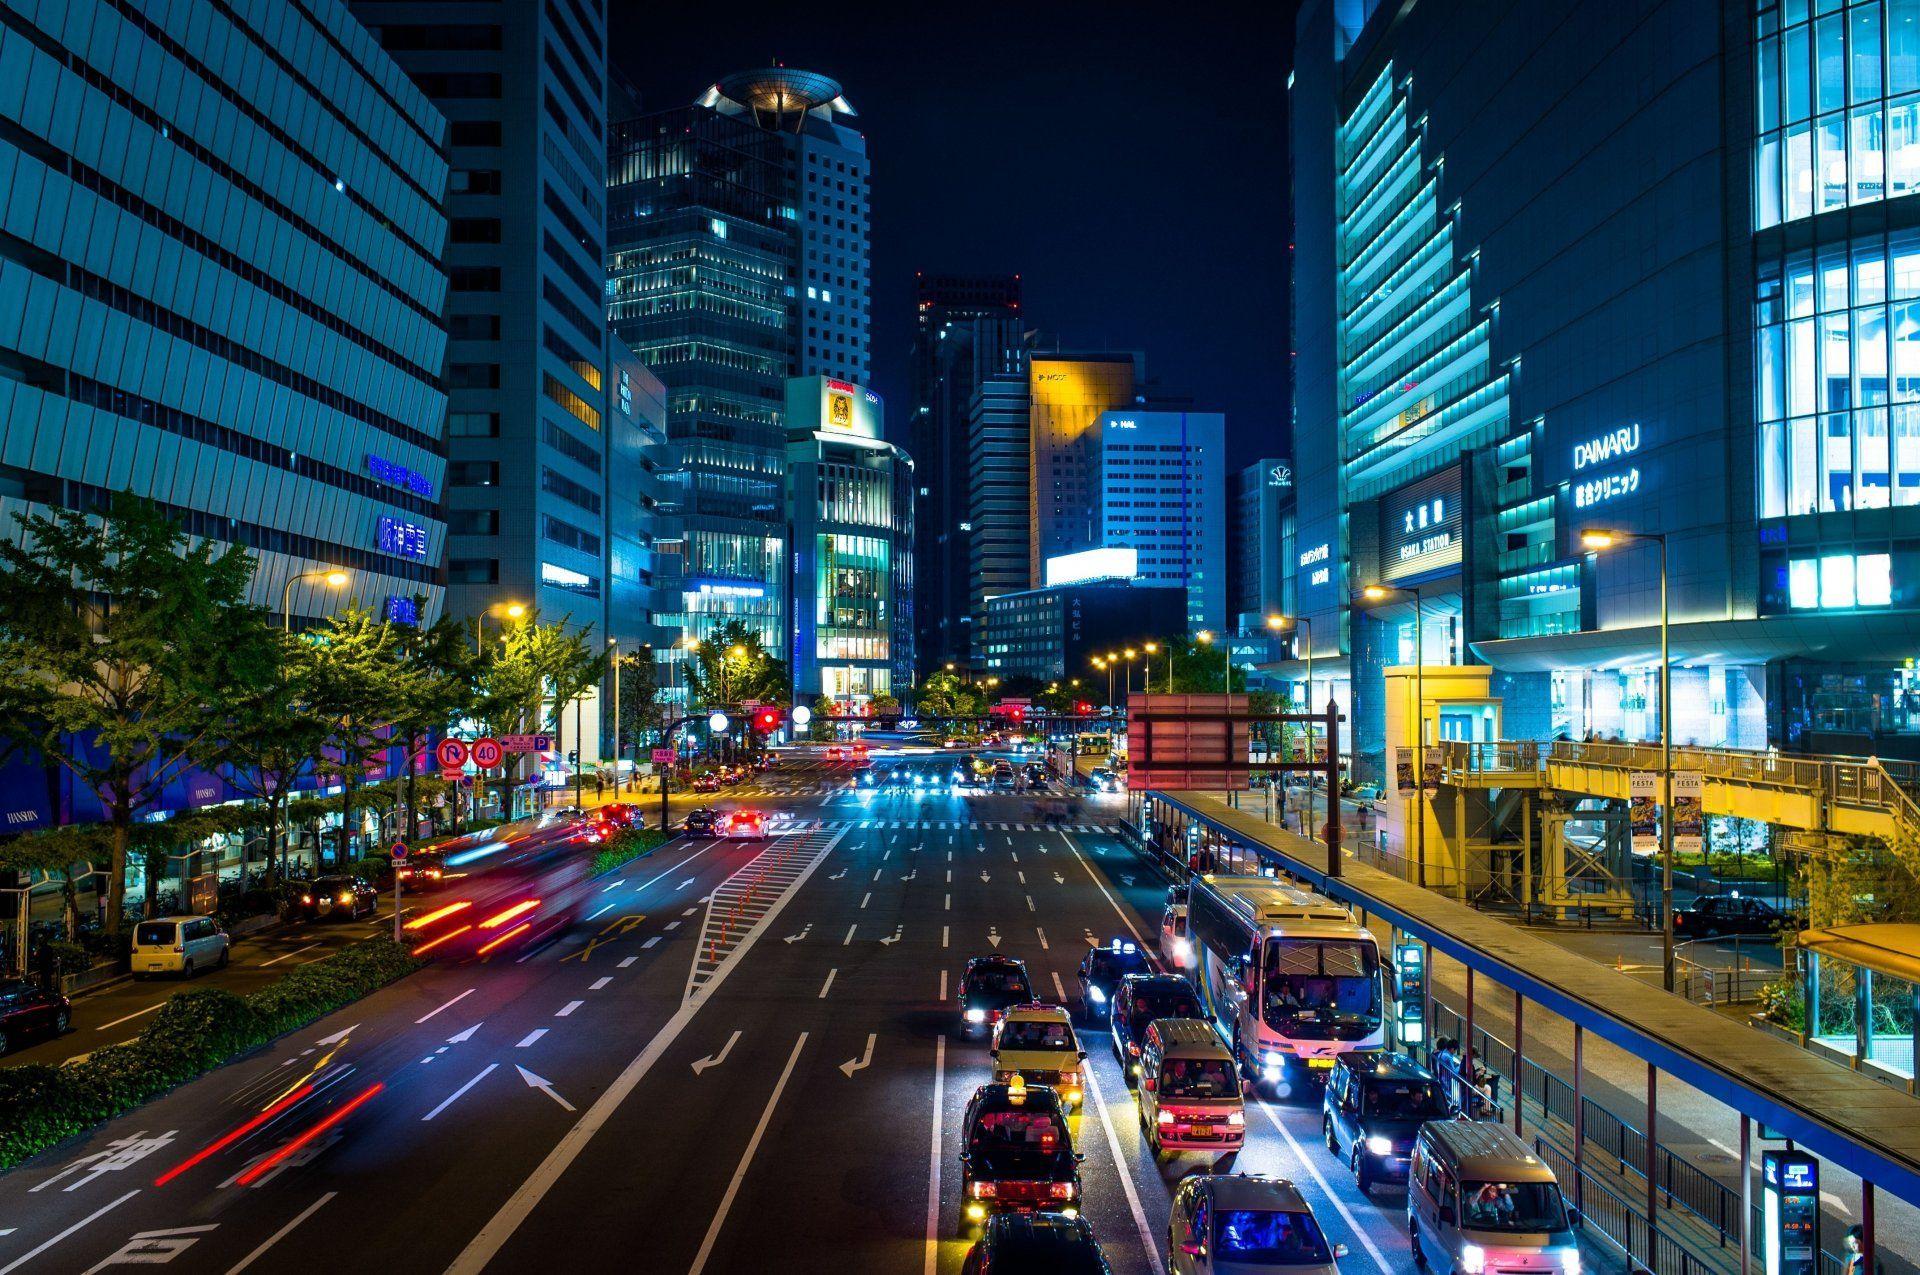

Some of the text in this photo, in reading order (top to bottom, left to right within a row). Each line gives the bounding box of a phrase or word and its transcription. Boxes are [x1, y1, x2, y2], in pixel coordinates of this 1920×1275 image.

[1120, 420, 1137, 429] HAL
[1574, 423, 1639, 470] DAIMARU
[1405, 499, 1443, 533] 大阪駅
[1400, 533, 1449, 560] OSAKA STATION
[538, 738, 546, 749] P
[478, 747, 495, 760] 40
[195, 787, 216, 800] HANSHIN
[7, 809, 39, 825] HANSHIN
